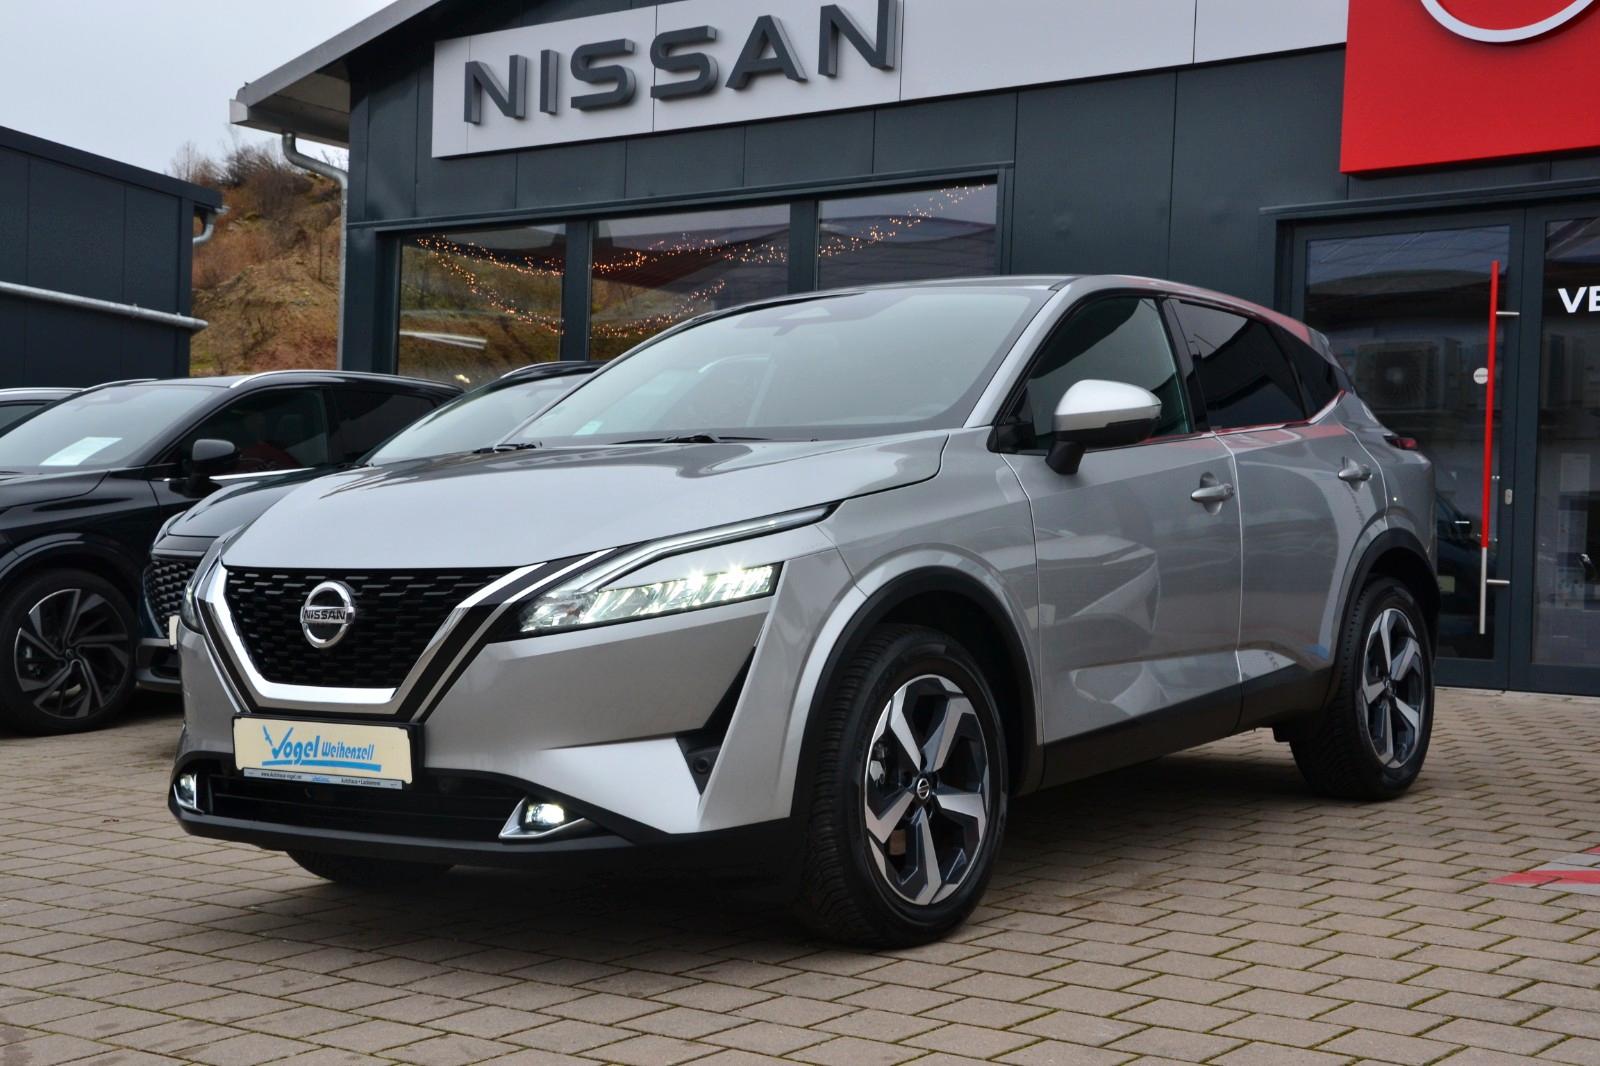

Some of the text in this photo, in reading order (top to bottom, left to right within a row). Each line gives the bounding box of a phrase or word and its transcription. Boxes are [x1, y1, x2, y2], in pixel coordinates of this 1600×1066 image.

[464, 0, 897, 125] NISSAN
[303, 609, 346, 620] NISSAN
[262, 725, 375, 765] Vogel Weihenzell
